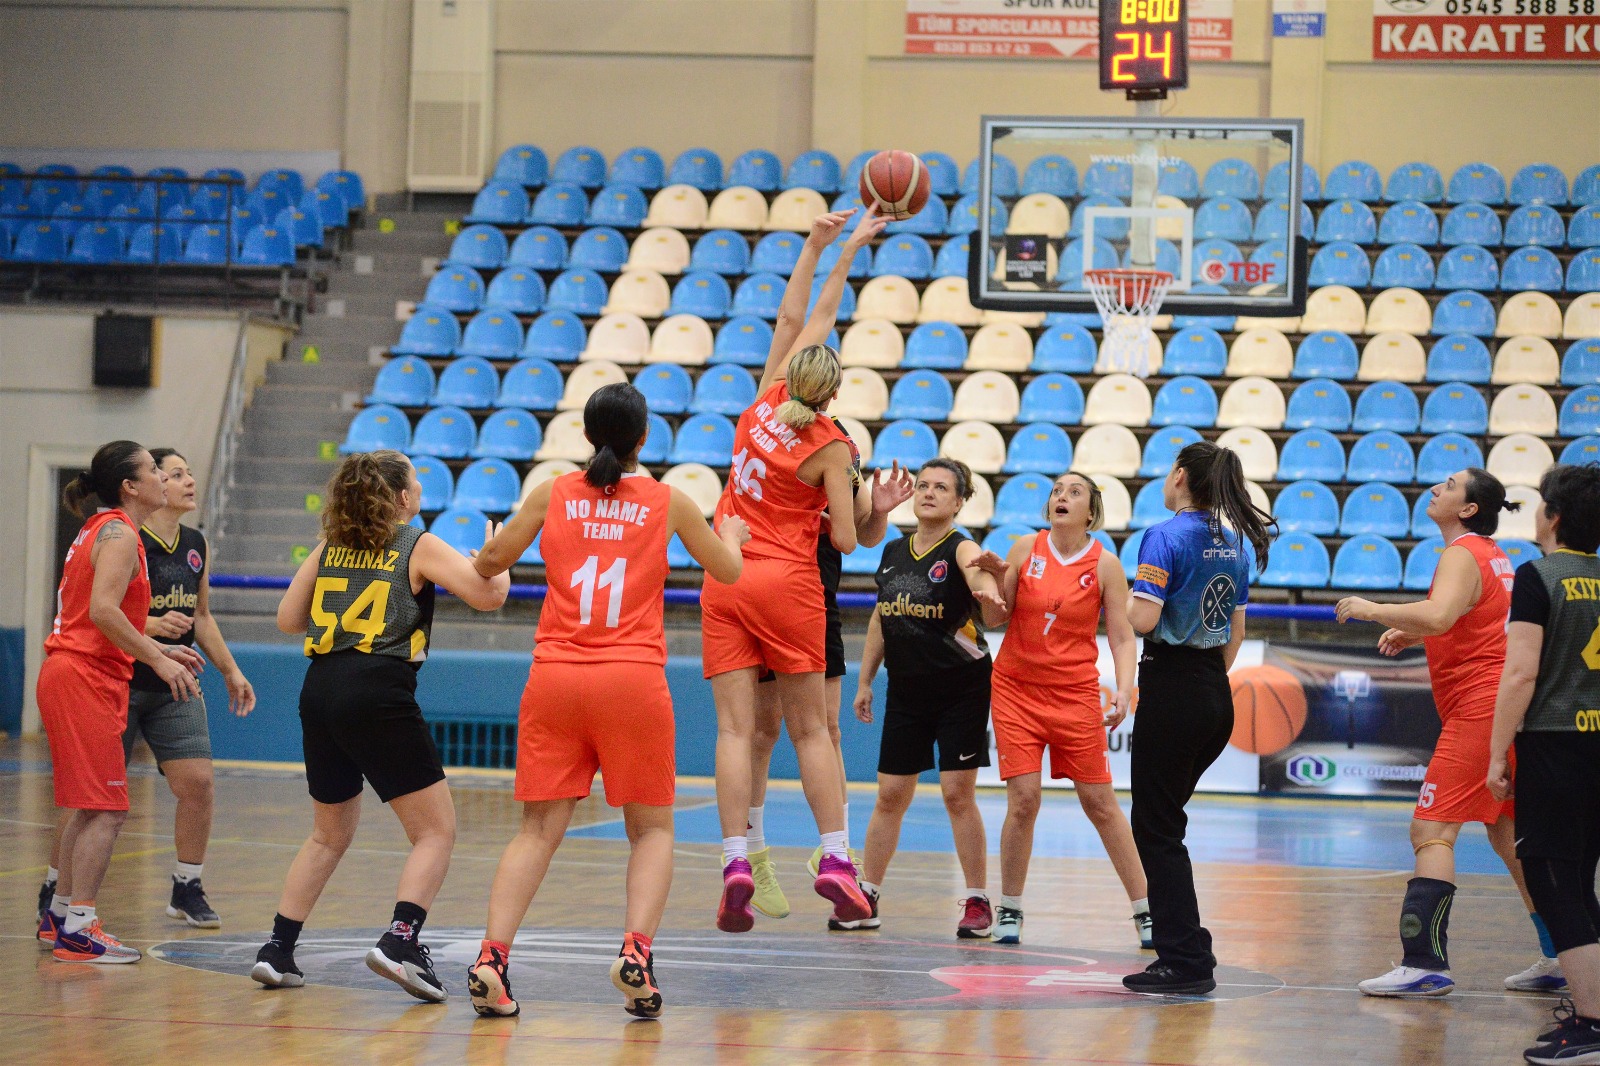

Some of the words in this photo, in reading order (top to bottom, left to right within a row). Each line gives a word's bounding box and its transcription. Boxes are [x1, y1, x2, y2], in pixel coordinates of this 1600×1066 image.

[1121, 0, 1179, 24] 8:00
[1446, 0, 1503, 14] 0545
[1515, 0, 1556, 14] 588
[957, 16, 1063, 35] SPORCULARA
[1381, 24, 1546, 52] KARATE
[1112, 31, 1171, 81] 24
[1228, 262, 1276, 283] TBF
[749, 424, 778, 453] TEAM
[732, 447, 766, 502] 16
[565, 499, 590, 521] NO
[595, 499, 650, 527] NAME
[583, 521, 624, 541] TEAM
[570, 555, 627, 628] 11
[303, 577, 391, 657] 54
[1043, 612, 1057, 636] 7
[1417, 781, 1437, 808] 15
